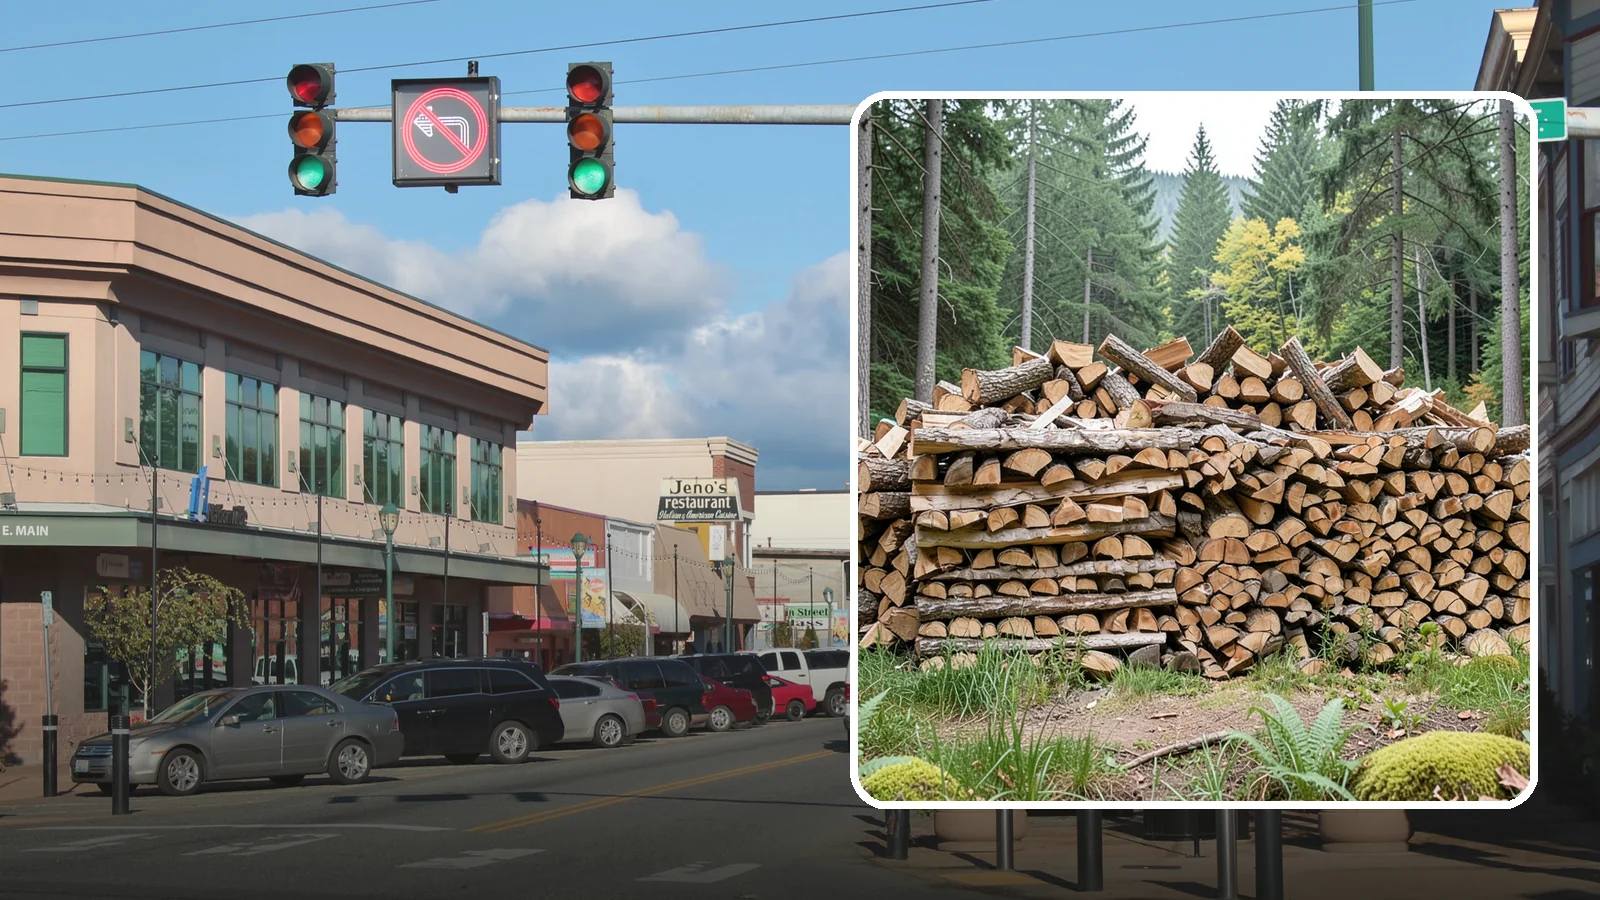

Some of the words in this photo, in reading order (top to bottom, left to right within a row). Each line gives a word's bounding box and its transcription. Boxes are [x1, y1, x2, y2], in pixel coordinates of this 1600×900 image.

[670, 480, 728, 494] Jeno's
[665, 497, 731, 509] restaurant
[658, 510, 681, 519] Italian
[686, 510, 714, 519] American
[715, 510, 738, 519] Cuisine
[2, 525, 13, 536] E.
[15, 525, 49, 536] MAIN
[797, 608, 828, 617] Street
